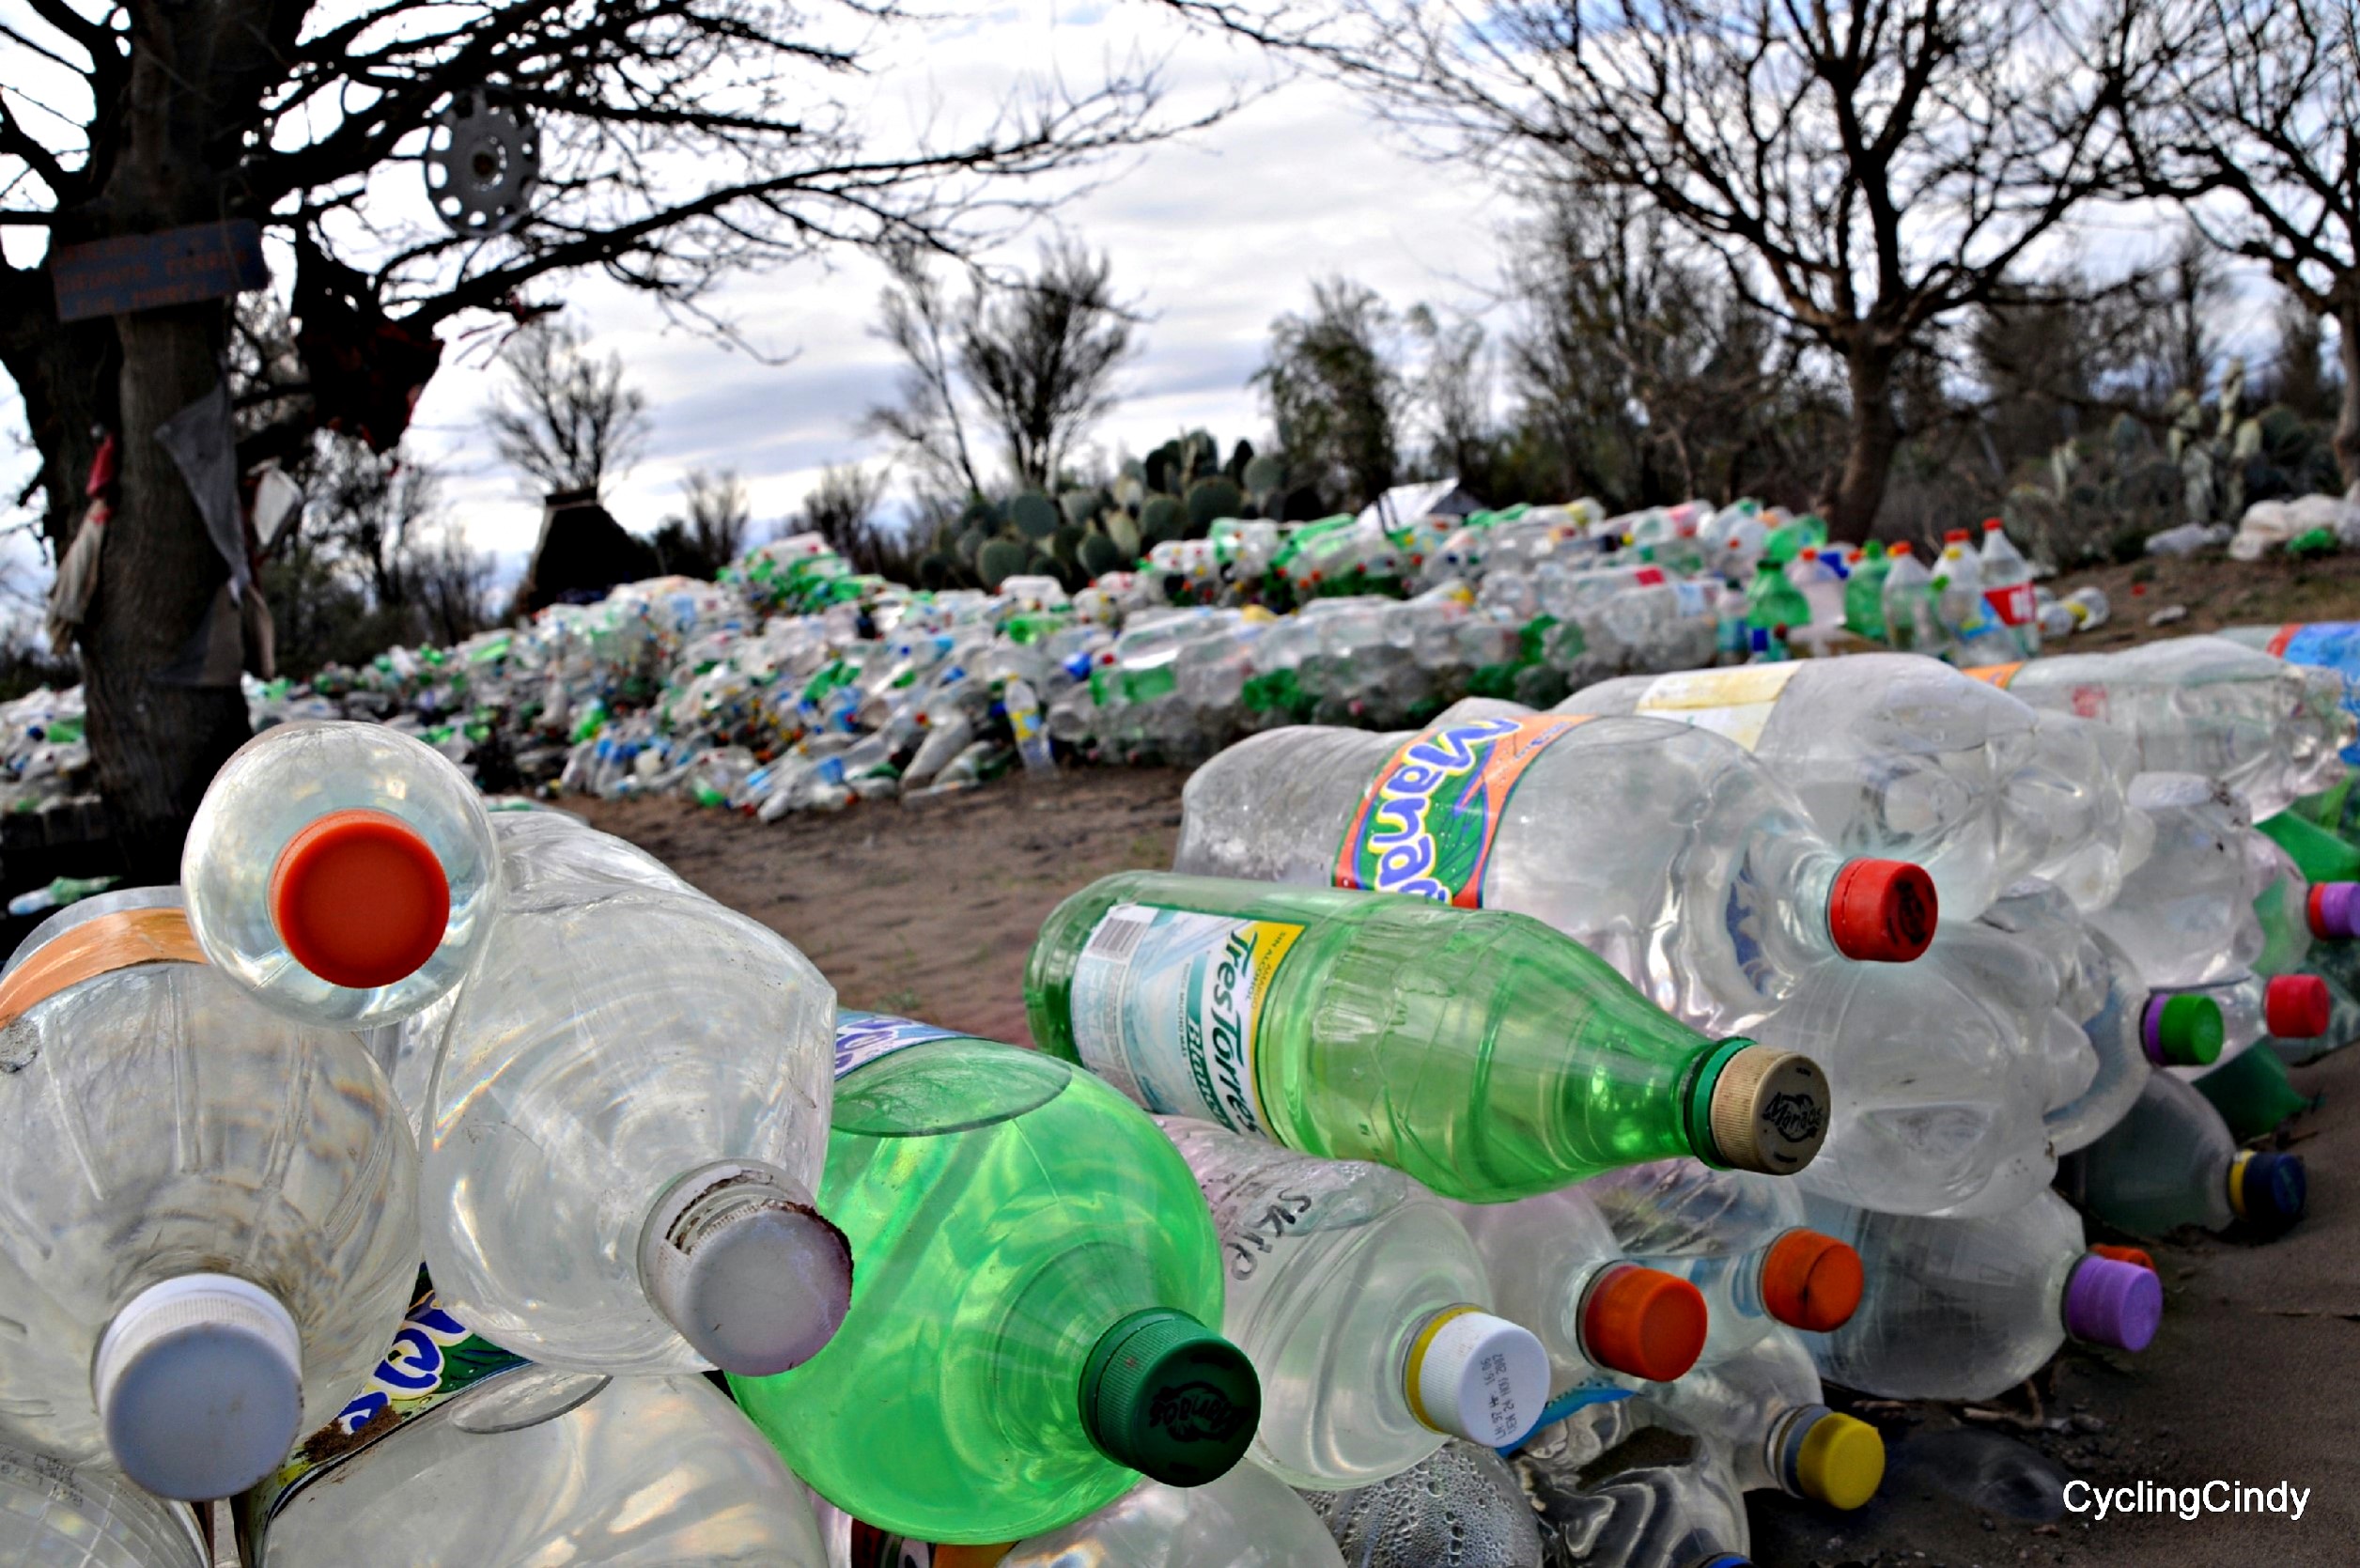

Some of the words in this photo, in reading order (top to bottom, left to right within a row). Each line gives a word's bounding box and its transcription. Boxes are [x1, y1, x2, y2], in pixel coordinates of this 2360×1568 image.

[1271, 931, 1287, 948] SIN
[1245, 948, 1273, 1001] ALCOHOL
[1178, 992, 1187, 1033] MUCHO
